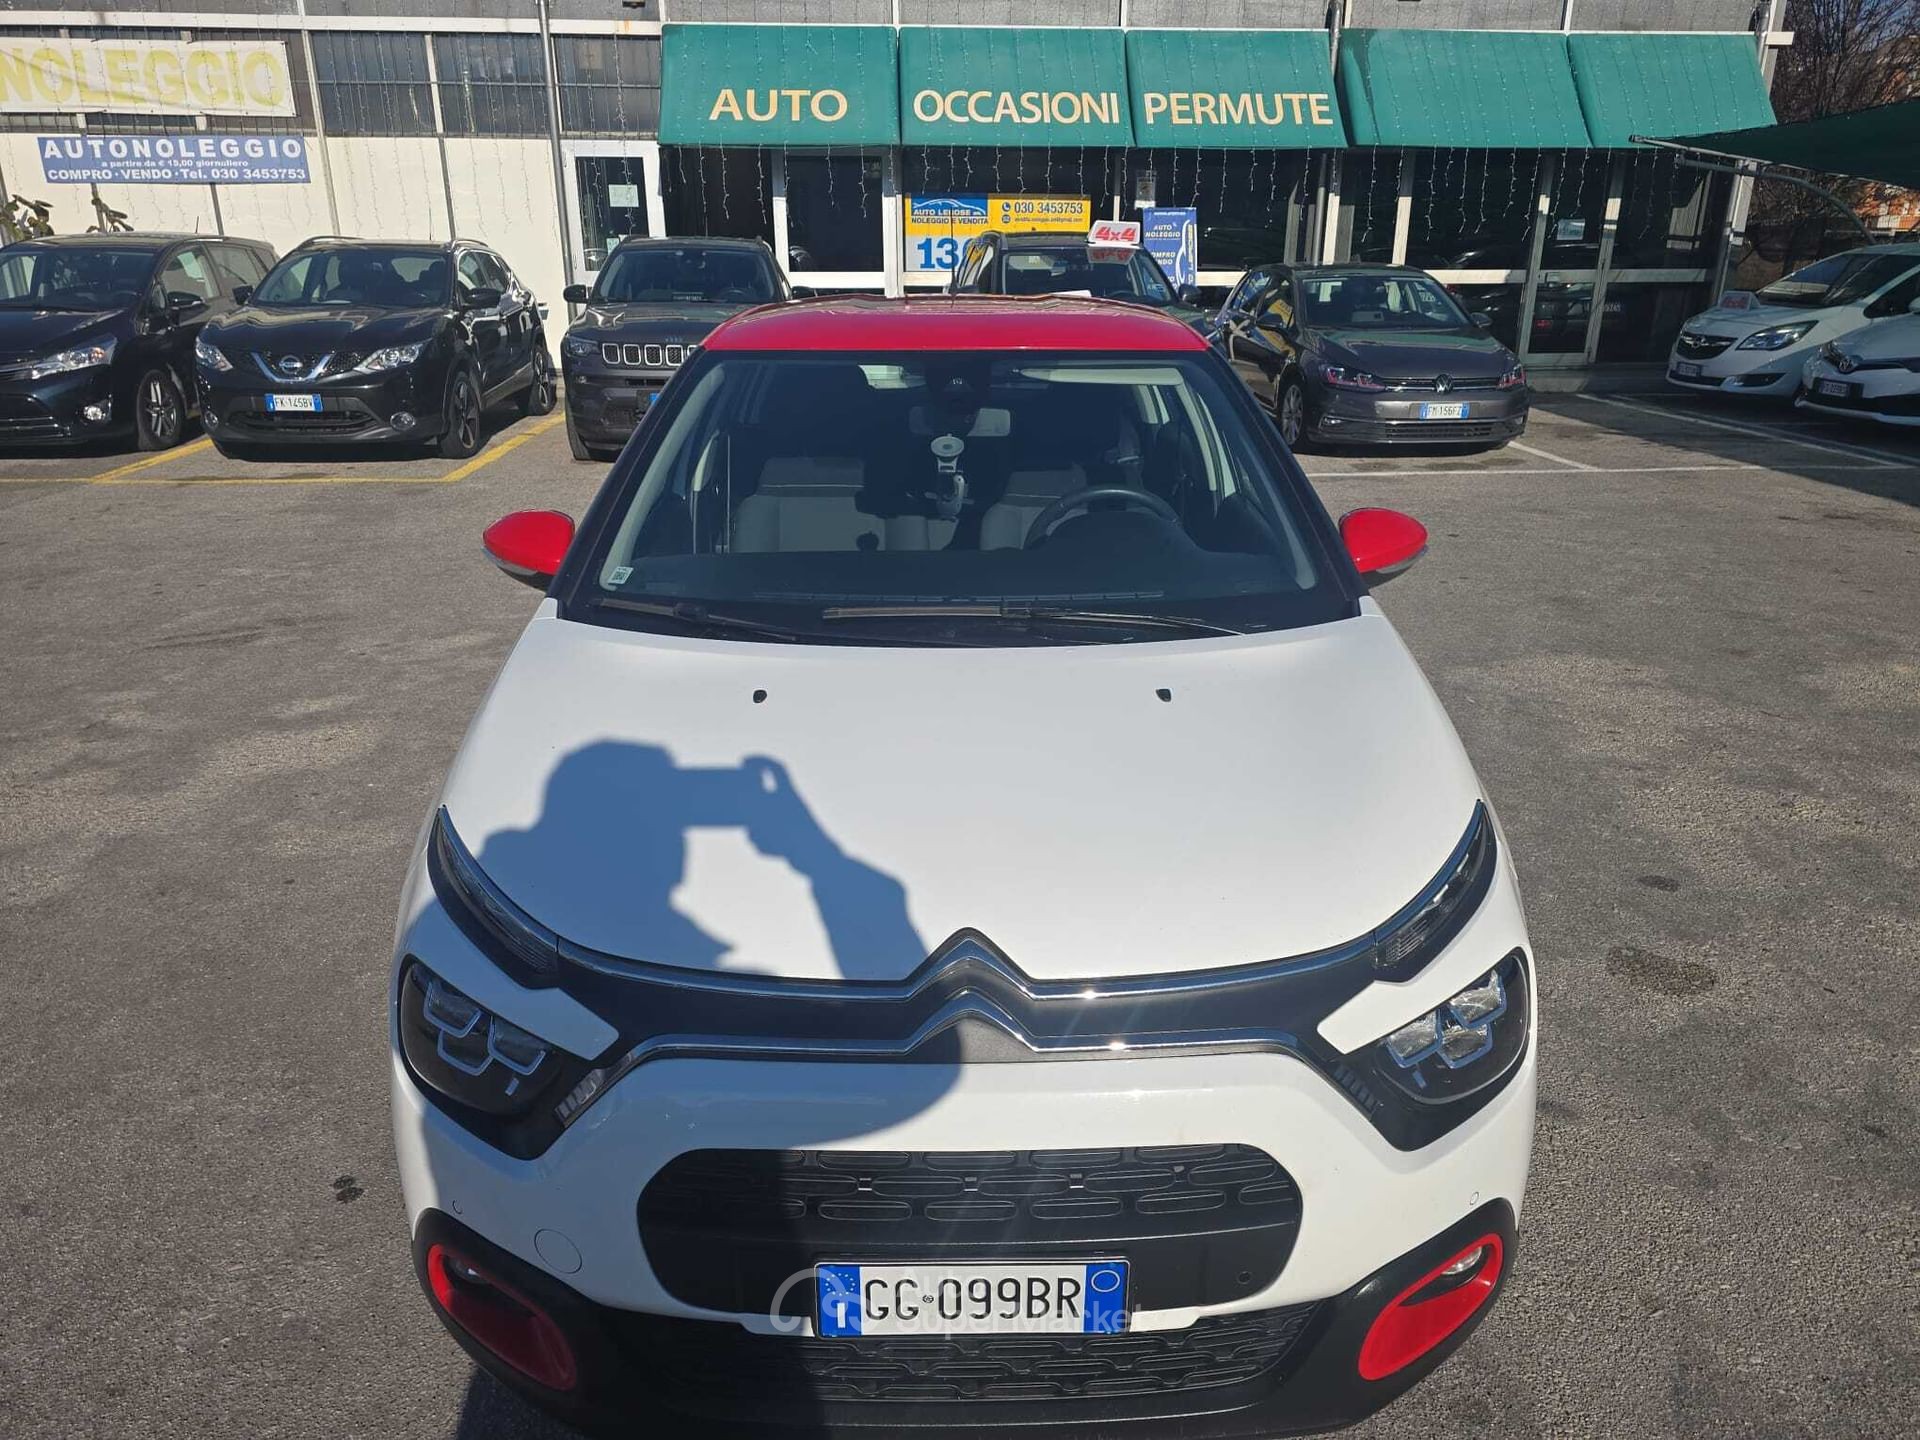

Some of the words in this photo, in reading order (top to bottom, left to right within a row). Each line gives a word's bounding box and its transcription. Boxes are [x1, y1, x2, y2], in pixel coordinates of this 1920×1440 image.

[0, 47, 284, 106] NOLEGGIO
[709, 88, 848, 122] AUTO
[913, 89, 1120, 124] OCCASIONI
[1143, 92, 1334, 125] PERMUTE
[44, 138, 301, 159] AUTONOLEGGIO
[48, 169, 112, 180] COMPRO
[121, 169, 172, 179] VENDO
[180, 169, 208, 179] Tel.
[211, 168, 239, 179] 030
[242, 168, 306, 179] 3453753
[1014, 202, 1034, 213] 030
[1037, 202, 1083, 214] 3453753
[911, 217, 950, 225] NOLEGGIO
[958, 217, 989, 225] VENDITA
[1095, 227, 1136, 241] 4x4
[865, 1279, 919, 1320] GG
[938, 1277, 1081, 1320] 099BR
